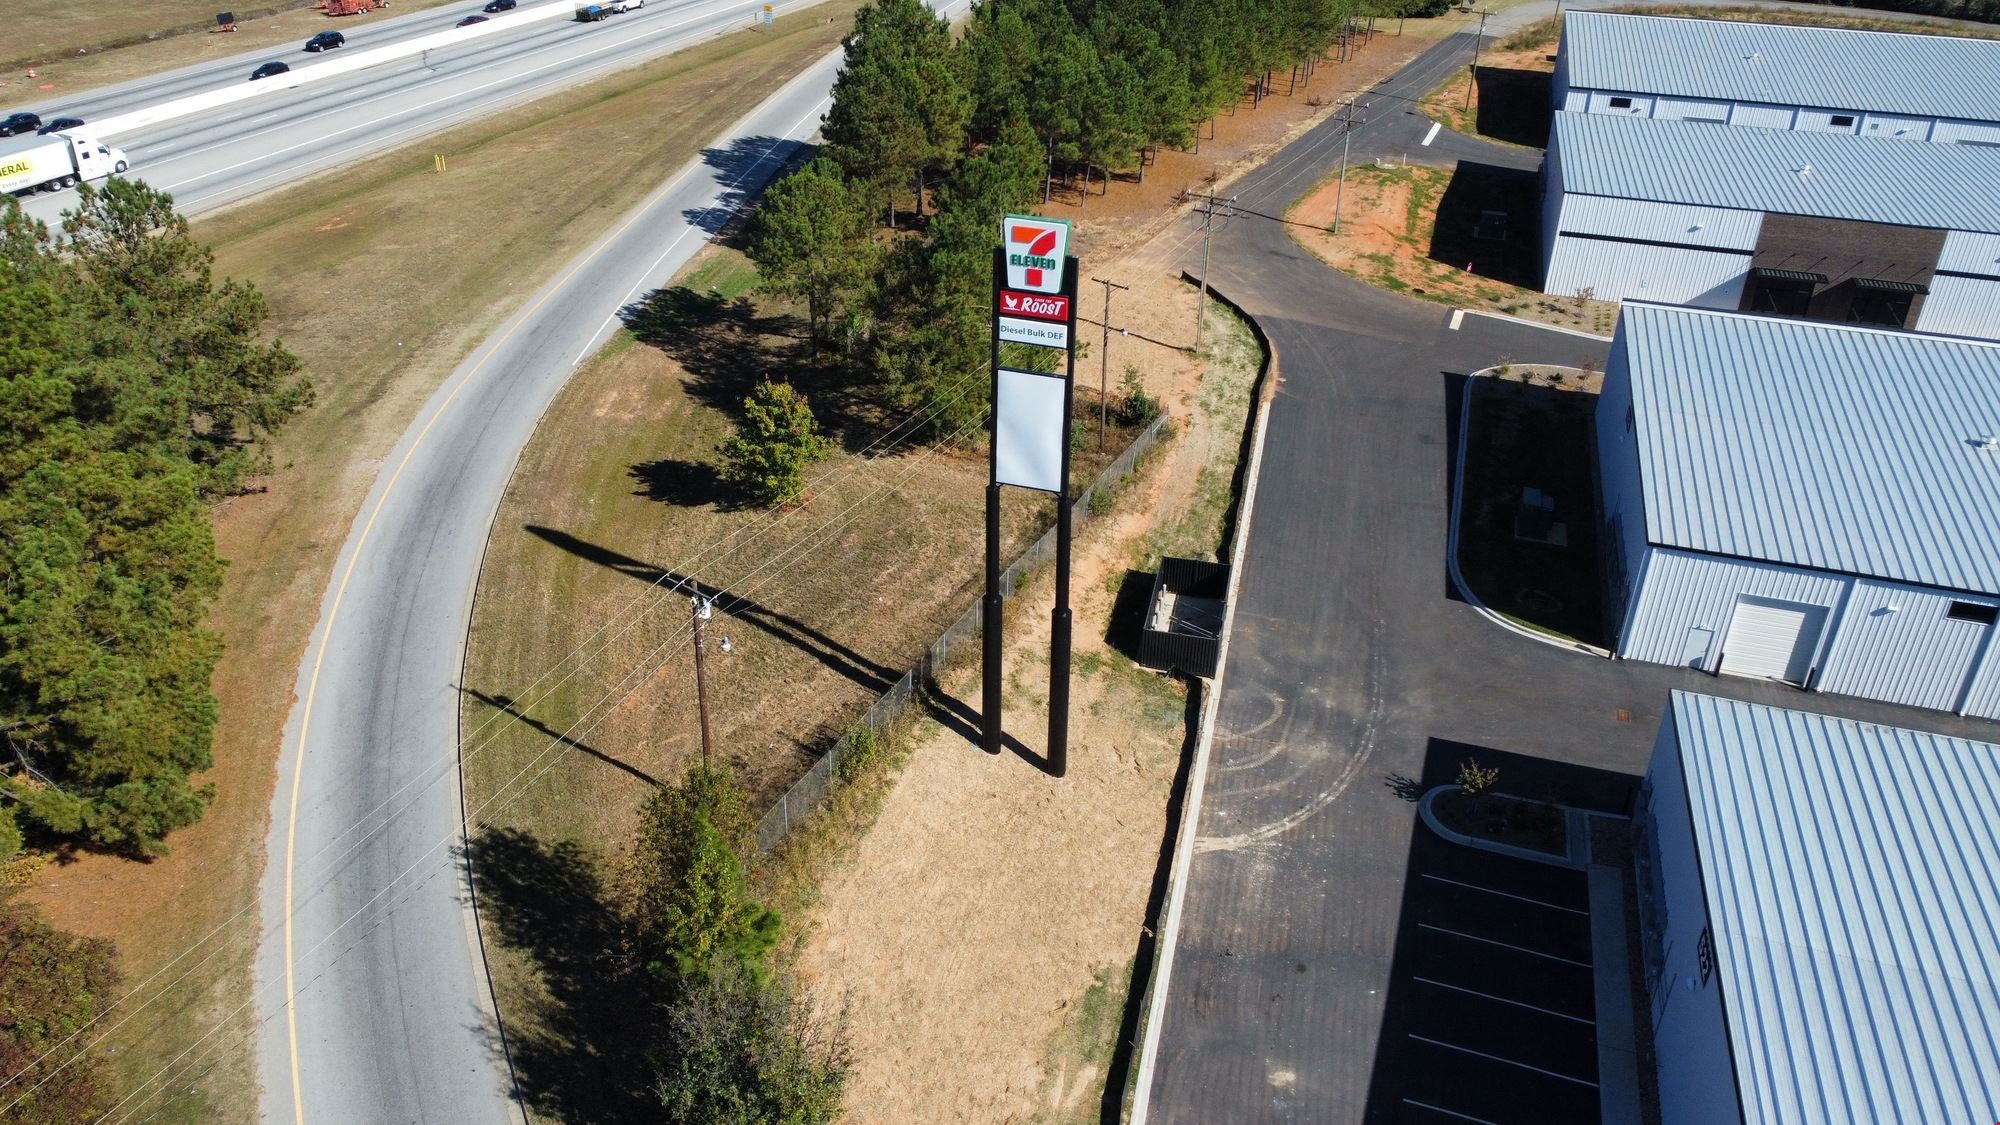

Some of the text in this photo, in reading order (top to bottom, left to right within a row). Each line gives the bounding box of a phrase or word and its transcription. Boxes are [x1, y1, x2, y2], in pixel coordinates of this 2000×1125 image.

[1000, 325, 1064, 340] Diesel Bulk DEF
